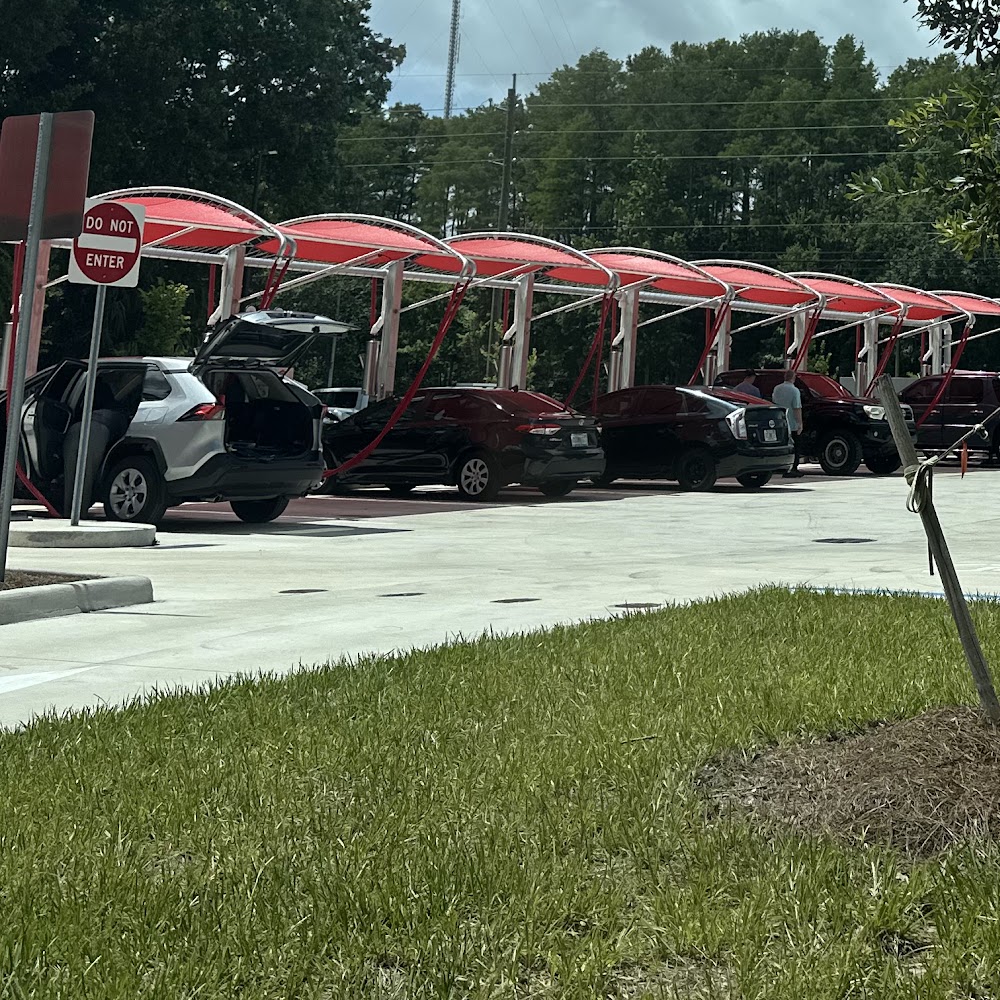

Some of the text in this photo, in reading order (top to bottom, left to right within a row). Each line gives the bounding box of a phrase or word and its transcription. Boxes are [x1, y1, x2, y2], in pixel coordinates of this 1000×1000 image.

[86, 216, 133, 233] DO NOT
[86, 253, 125, 269] ENTER
